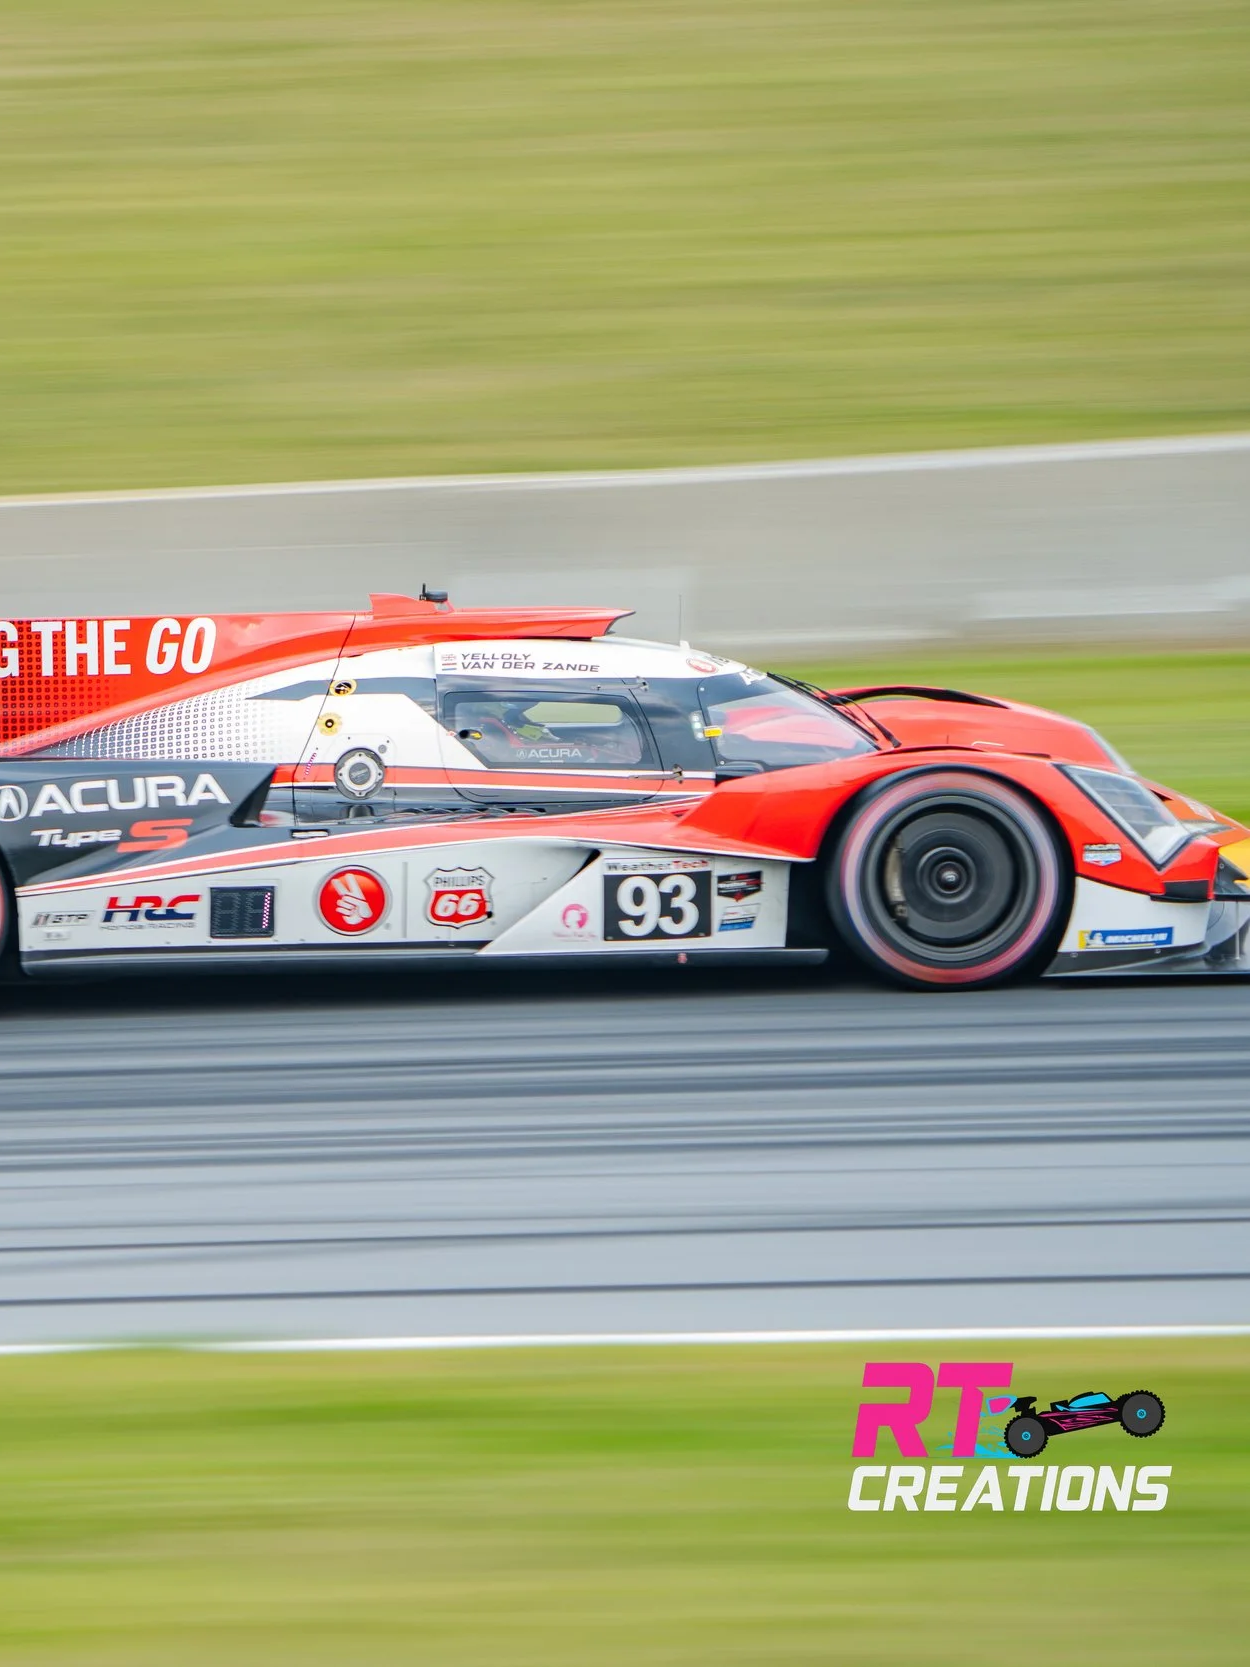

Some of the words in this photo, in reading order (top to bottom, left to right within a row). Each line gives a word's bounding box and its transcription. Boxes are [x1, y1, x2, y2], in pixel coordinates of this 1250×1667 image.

[31, 620, 132, 677] THE
[145, 617, 217, 674] GO
[542, 663, 600, 672] ZANDE
[528, 748, 582, 758] ACURA
[29, 773, 231, 817] ACURA
[30, 828, 122, 847] Type
[117, 818, 194, 852] S
[606, 860, 709, 871] WeatherTech
[433, 875, 486, 887] PHILLIPS
[102, 894, 201, 922] HRC
[434, 893, 482, 917] 66
[616, 874, 700, 937] 93
[1104, 933, 1168, 943] MICHELIN
